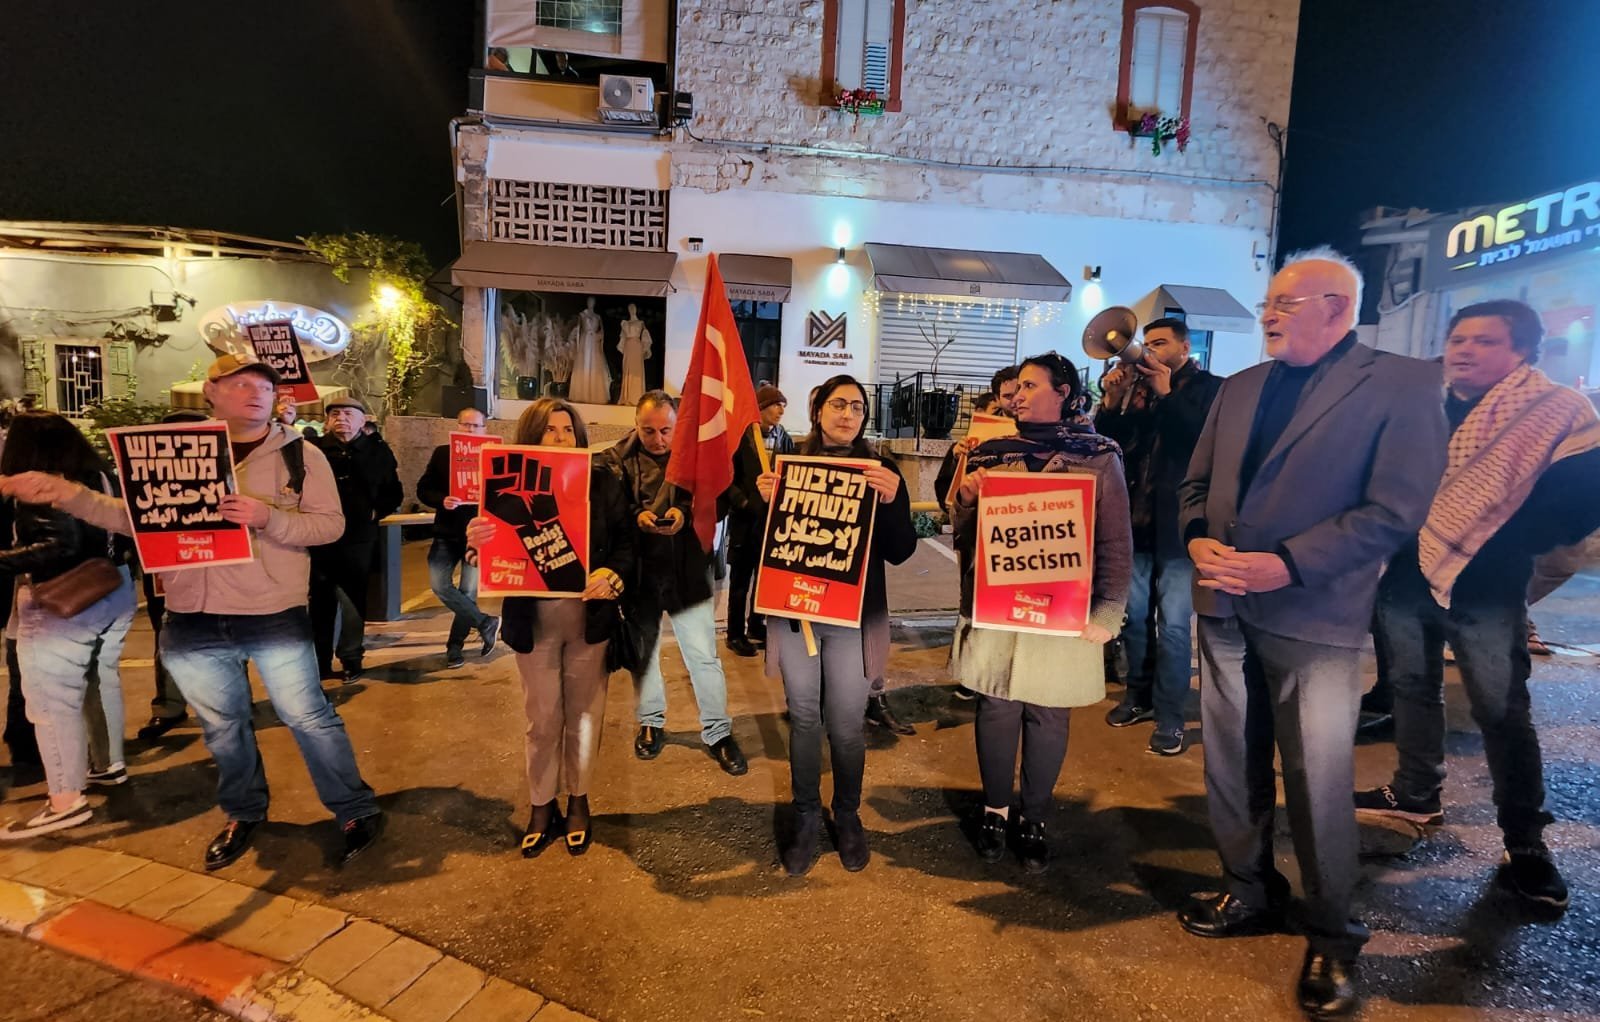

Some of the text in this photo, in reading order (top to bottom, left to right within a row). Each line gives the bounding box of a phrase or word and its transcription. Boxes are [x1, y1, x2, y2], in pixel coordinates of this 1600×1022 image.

[1479, 243, 1522, 266] לבית
[537, 279, 565, 288] MAYADA
[729, 287, 776, 297] MAYADA SABA
[250, 325, 290, 340] הכיבוש
[255, 340, 293, 354] משחית
[797, 350, 853, 360] MAYADA SABA
[124, 435, 218, 458] הכיבוש
[130, 458, 218, 481] משחית
[785, 464, 867, 499] הכיבוש
[136, 481, 225, 509] الاحتلال
[779, 488, 861, 523] משחית
[140, 507, 178, 528] البلاء
[986, 498, 1075, 516] Arabs & Jews
[523, 524, 564, 550] Resist
[774, 515, 861, 551] الاحتلال
[990, 519, 1076, 548] Against
[770, 543, 855, 572] أساس البلاء
[991, 549, 1081, 572] Fascism
